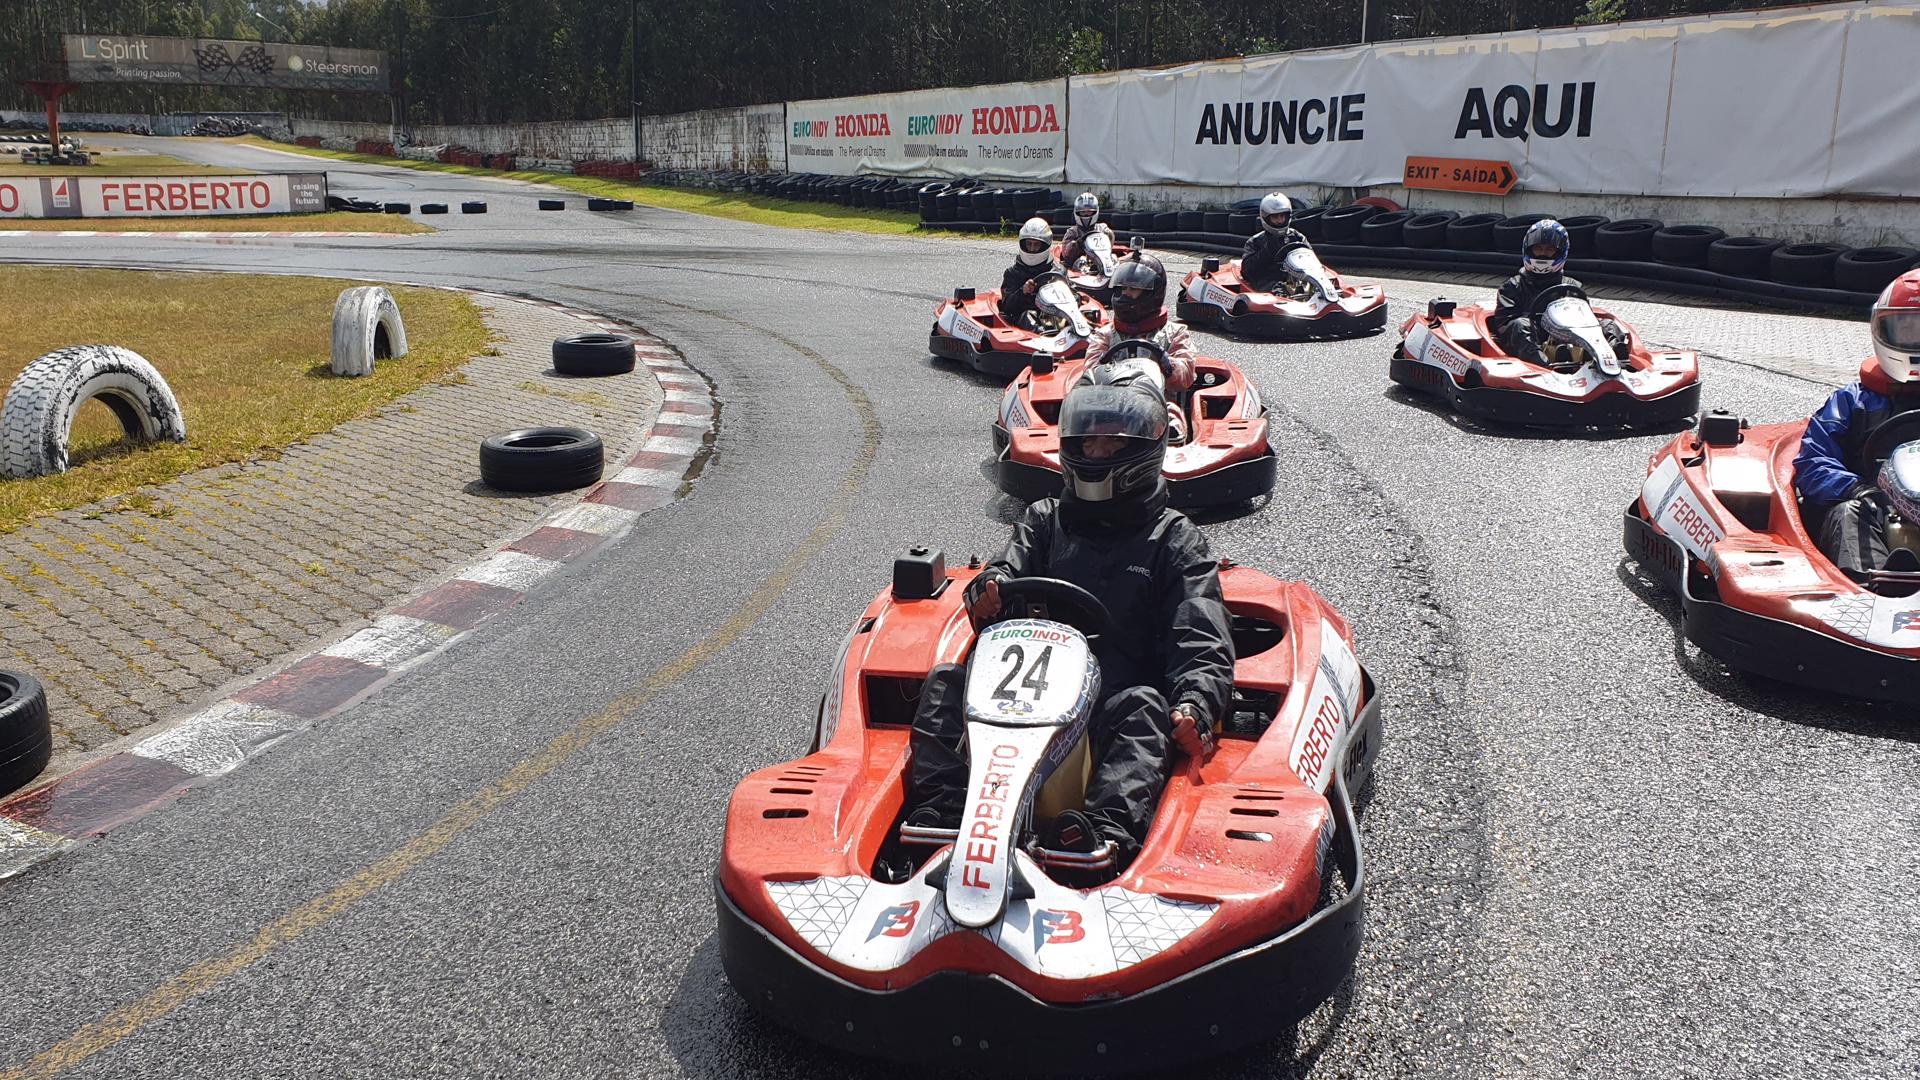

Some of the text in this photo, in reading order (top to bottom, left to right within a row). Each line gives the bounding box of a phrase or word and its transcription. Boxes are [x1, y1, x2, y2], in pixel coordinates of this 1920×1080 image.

[116, 67, 148, 80] Printing
[305, 59, 378, 75] Steersman
[907, 103, 1060, 136] EUROINDY HONDA
[1195, 92, 1366, 145] ANUNCIE
[1454, 81, 1596, 143] AQUI
[793, 113, 891, 138] EUROINDY HONDA
[839, 146, 848, 157] The
[848, 146, 862, 158] Power
[869, 146, 886, 158] Dreams
[978, 145, 992, 159] The
[993, 145, 1014, 159] Power
[1023, 145, 1054, 159] Dreams
[1406, 165, 1439, 180] EXIT
[1453, 166, 1498, 184] SAÍDA
[101, 181, 271, 211] FERBERTO
[293, 183, 319, 191] raising
[295, 197, 320, 205] future
[1427, 343, 1467, 375] FERBERTO
[990, 629, 1071, 643] EUROINDY
[990, 644, 1053, 701] 24
[962, 744, 1020, 890] FERBERTO
